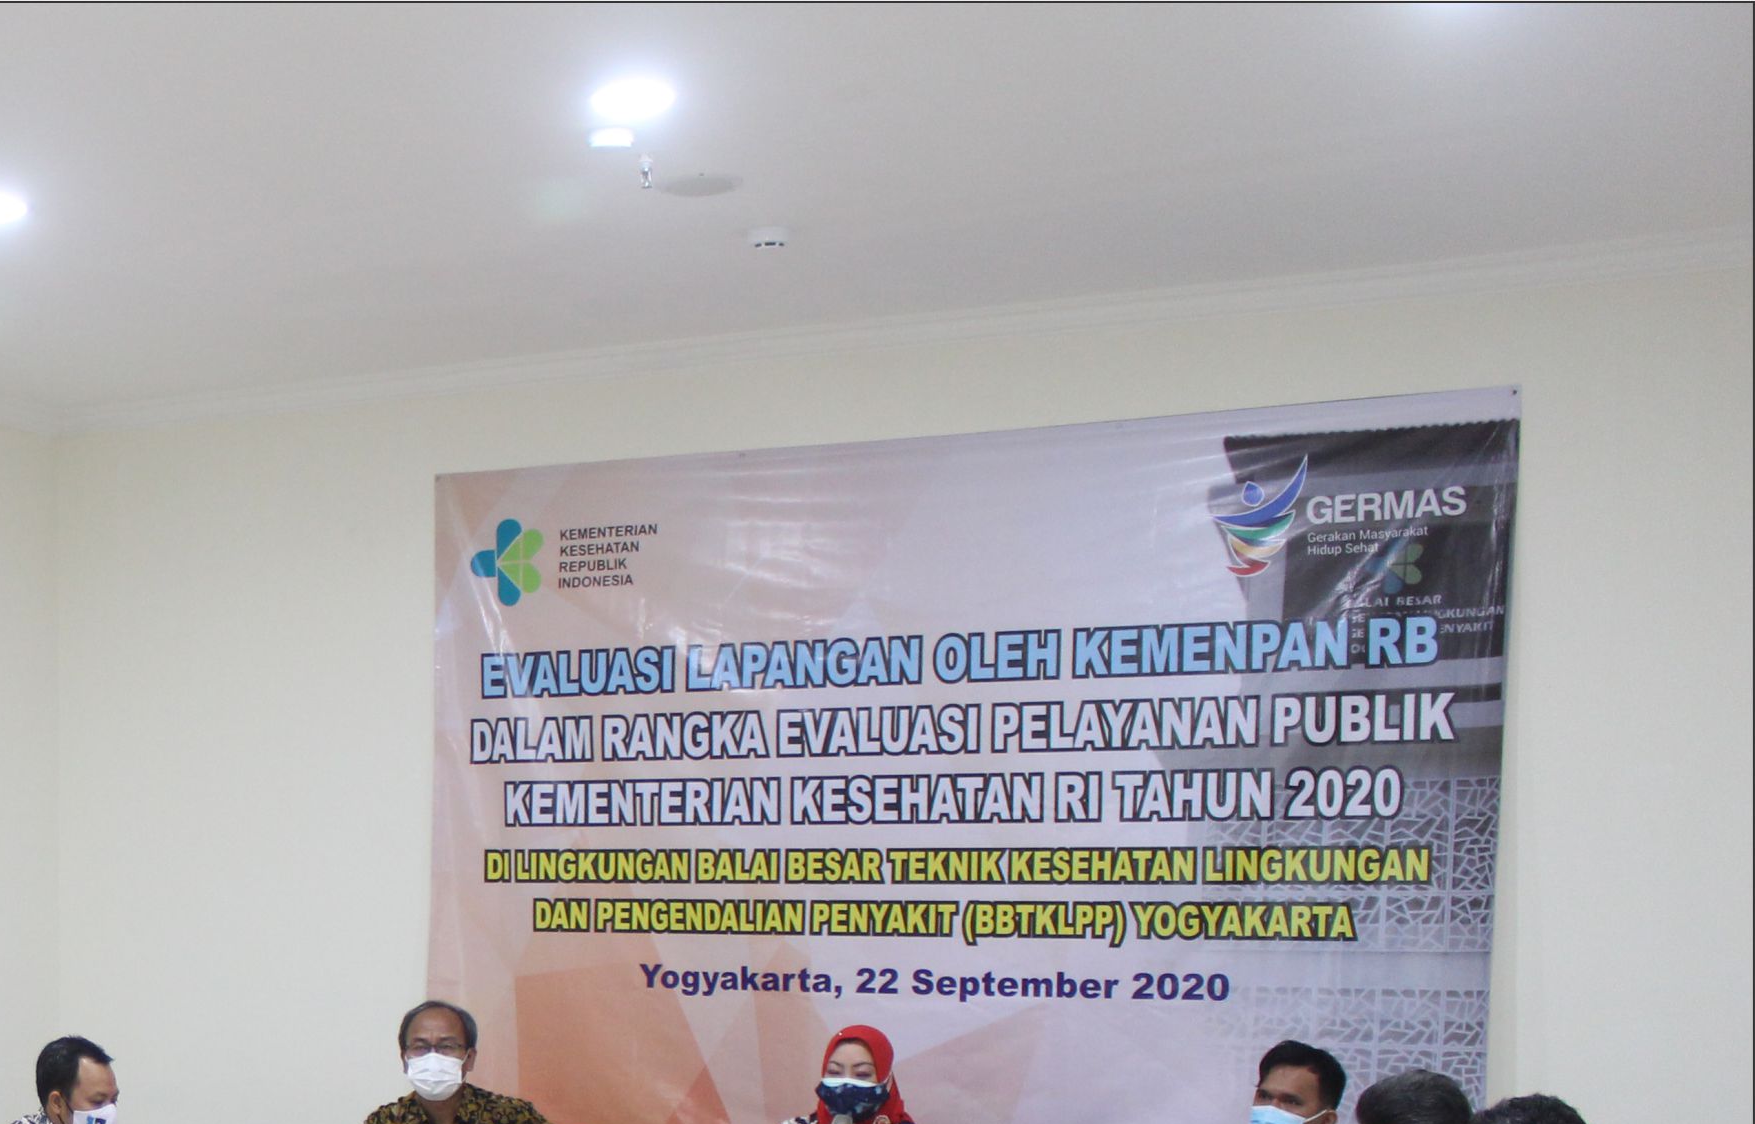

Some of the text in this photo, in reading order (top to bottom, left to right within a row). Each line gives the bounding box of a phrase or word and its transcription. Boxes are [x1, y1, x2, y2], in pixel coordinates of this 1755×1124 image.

[1306, 486, 1467, 525] GERMAS
[560, 524, 658, 541] KEMENTERIAN
[560, 541, 640, 557] KESEHATAN
[1307, 526, 1429, 544] Gerakan Masyarakat
[1307, 542, 1379, 556] Hidup Sehat
[558, 575, 633, 588] INDONESIA
[559, 558, 627, 572] REPUBLIK
[480, 615, 1440, 699] EVALUASI LAPANGAN OLEH KEMENPAN RB
[470, 691, 1457, 764] DALAM RANGKA EVALUASI PELAYANAN PUBLIK
[504, 767, 1404, 827] KEMENTERIAN KESEHATAN RI TAHUN 2020
[484, 846, 1433, 884] DI LINGKUNGAN BALAI BESAR TEKNIK KESEHATAN LINGKUNGAN
[533, 898, 1358, 947] DAN PENGENDALIAN PENYAKIT (BBTKLPP) YOGYAKARTA
[640, 963, 1230, 1002] Yogyakarta, 22 September 2020
